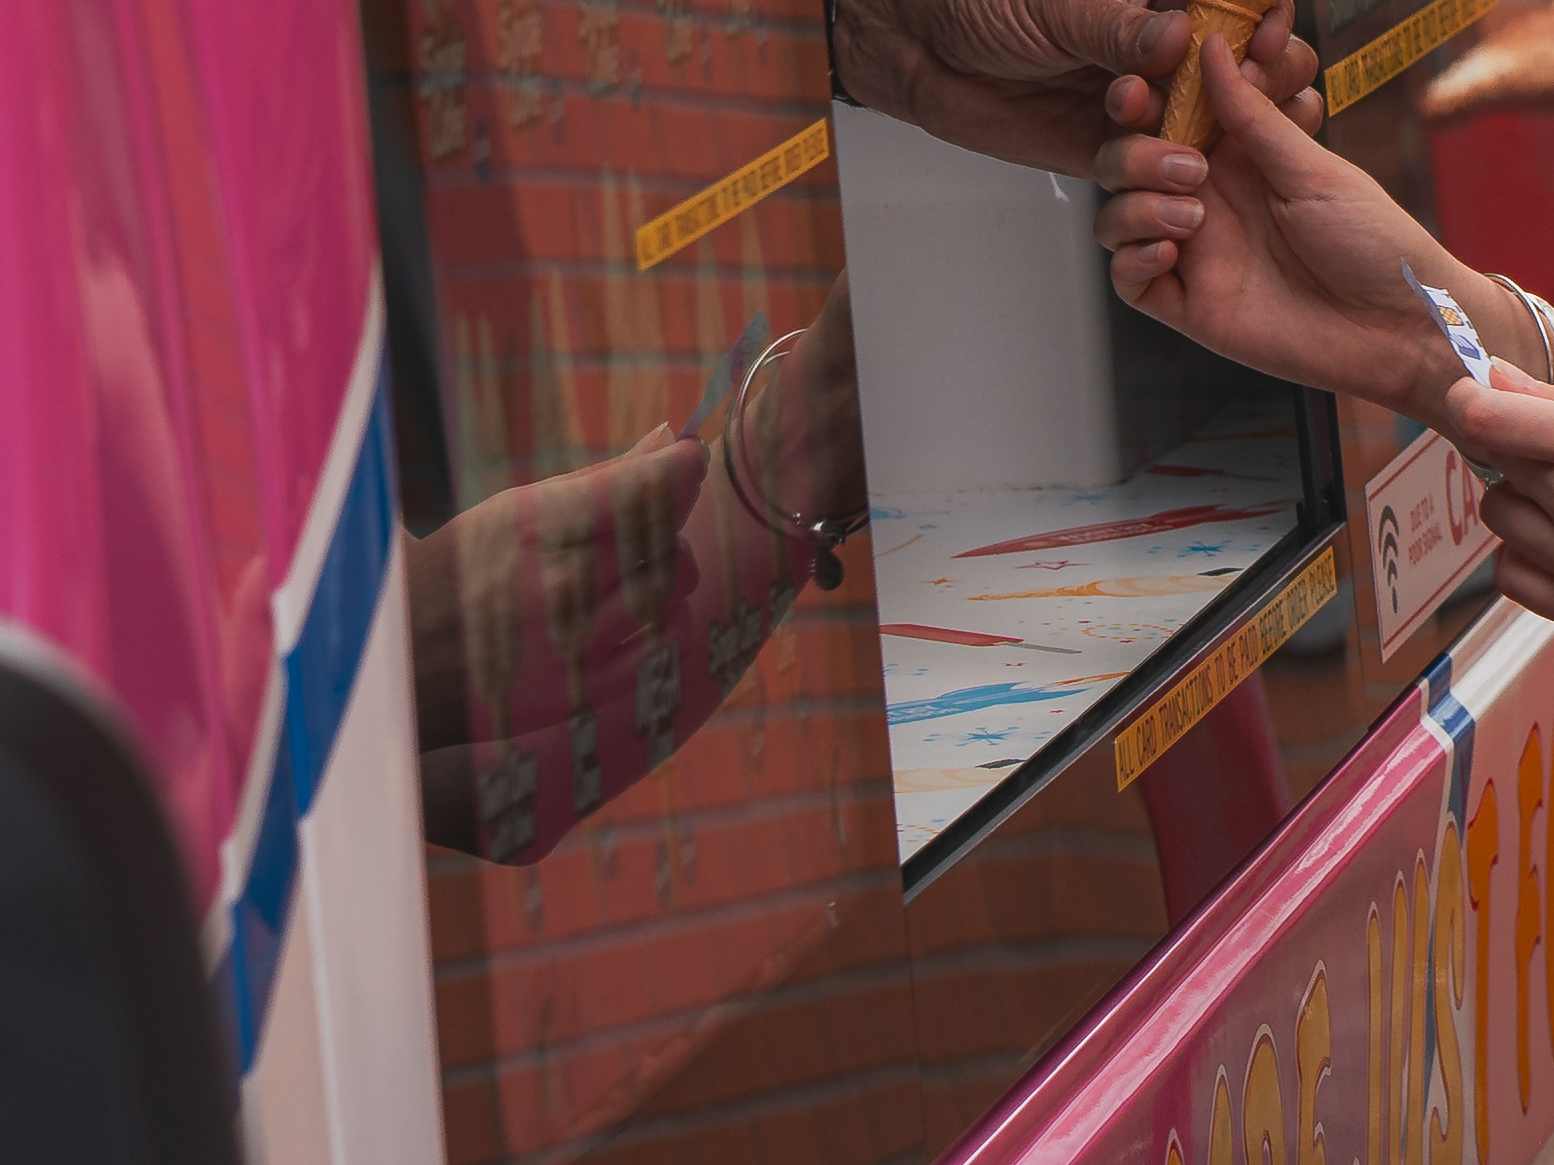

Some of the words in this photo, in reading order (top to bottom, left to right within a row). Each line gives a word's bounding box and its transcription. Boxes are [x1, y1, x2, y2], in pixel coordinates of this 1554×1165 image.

[1119, 741, 1134, 780] ALL
[1136, 714, 1157, 766] CARD
[1159, 665, 1214, 746] TRANSACTIONS
[1215, 652, 1226, 694] TO
[1227, 642, 1239, 684] BE
[1239, 625, 1258, 671] PAID
[1259, 599, 1286, 655] BEFORE
[1286, 579, 1309, 629] ORDER
[1309, 554, 1335, 604] PLEASE
[1358, 777, 1499, 1165] JUST
